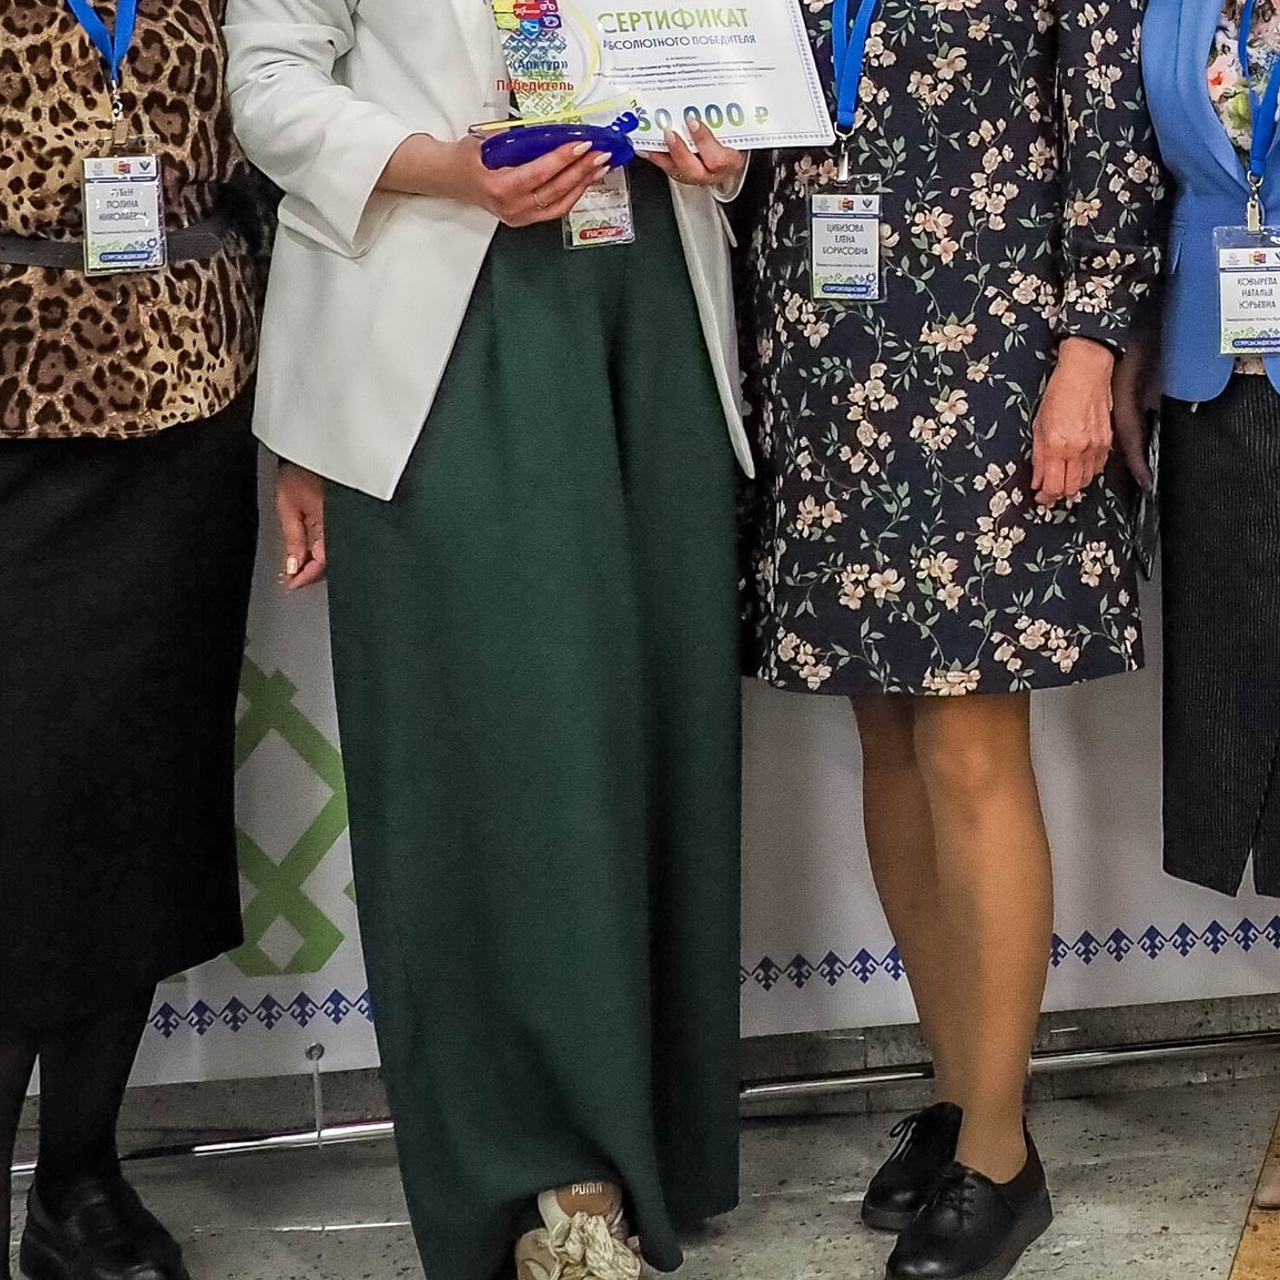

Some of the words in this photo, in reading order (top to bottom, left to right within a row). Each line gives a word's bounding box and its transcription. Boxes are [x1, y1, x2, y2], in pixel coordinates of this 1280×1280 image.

[597, 7, 749, 34] СЕРТИФИКАТ
[692, 33, 756, 47] ПОБЕДИТЕЛЯ
[496, 79, 574, 92] Победитель
[571, 1182, 602, 1196] PUMA
